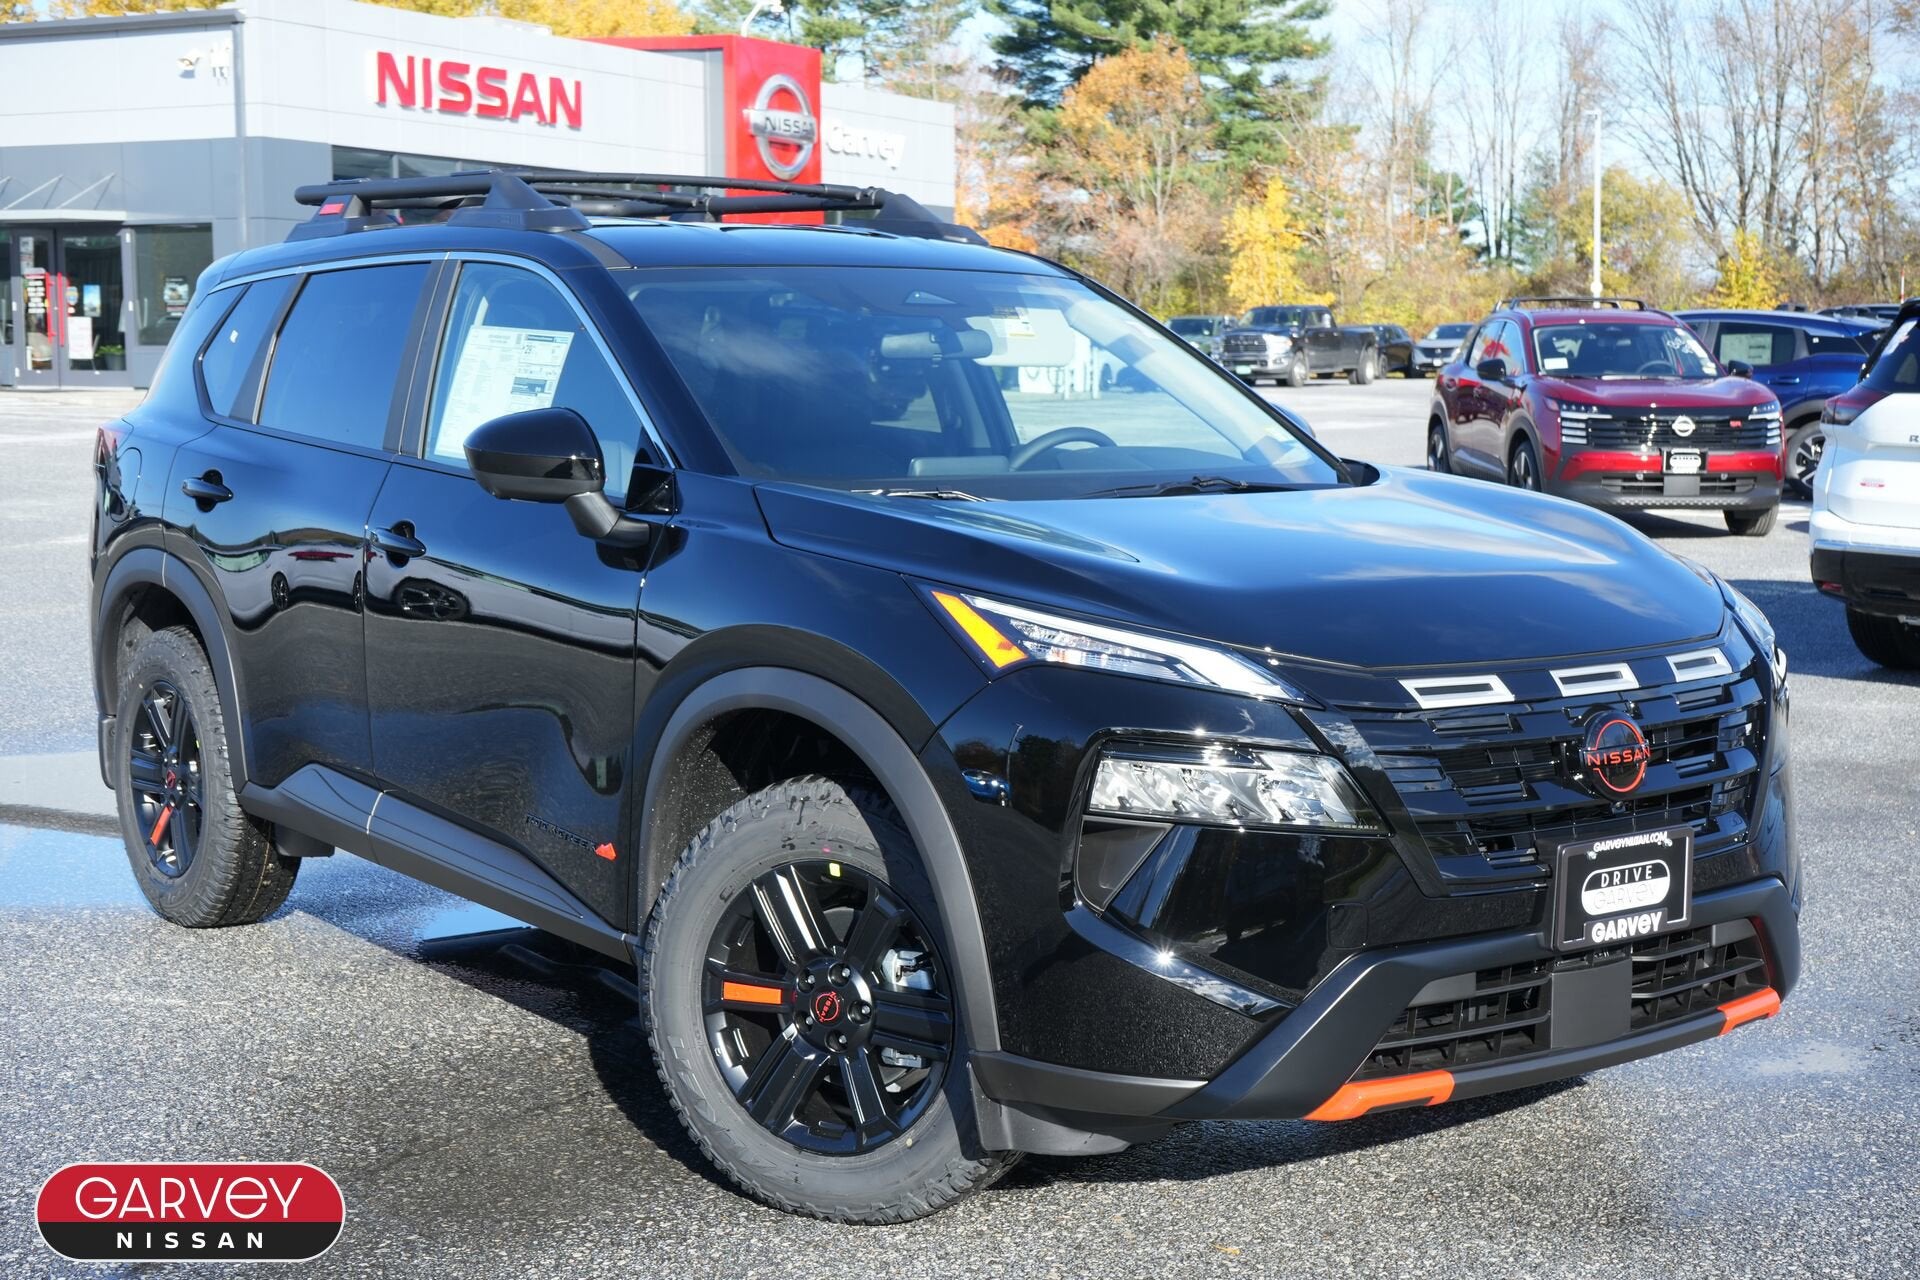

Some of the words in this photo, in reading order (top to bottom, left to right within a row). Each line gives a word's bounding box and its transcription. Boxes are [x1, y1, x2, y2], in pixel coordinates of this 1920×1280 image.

[377, 51, 582, 129] NISSAN
[764, 116, 815, 135] NISSAN
[826, 119, 907, 171] Garvey
[1586, 746, 1651, 767] NISSAN
[1601, 865, 1652, 888] DRIVE
[1591, 911, 1662, 943] GARVEY
[819, 991, 837, 1023] NISSAN
